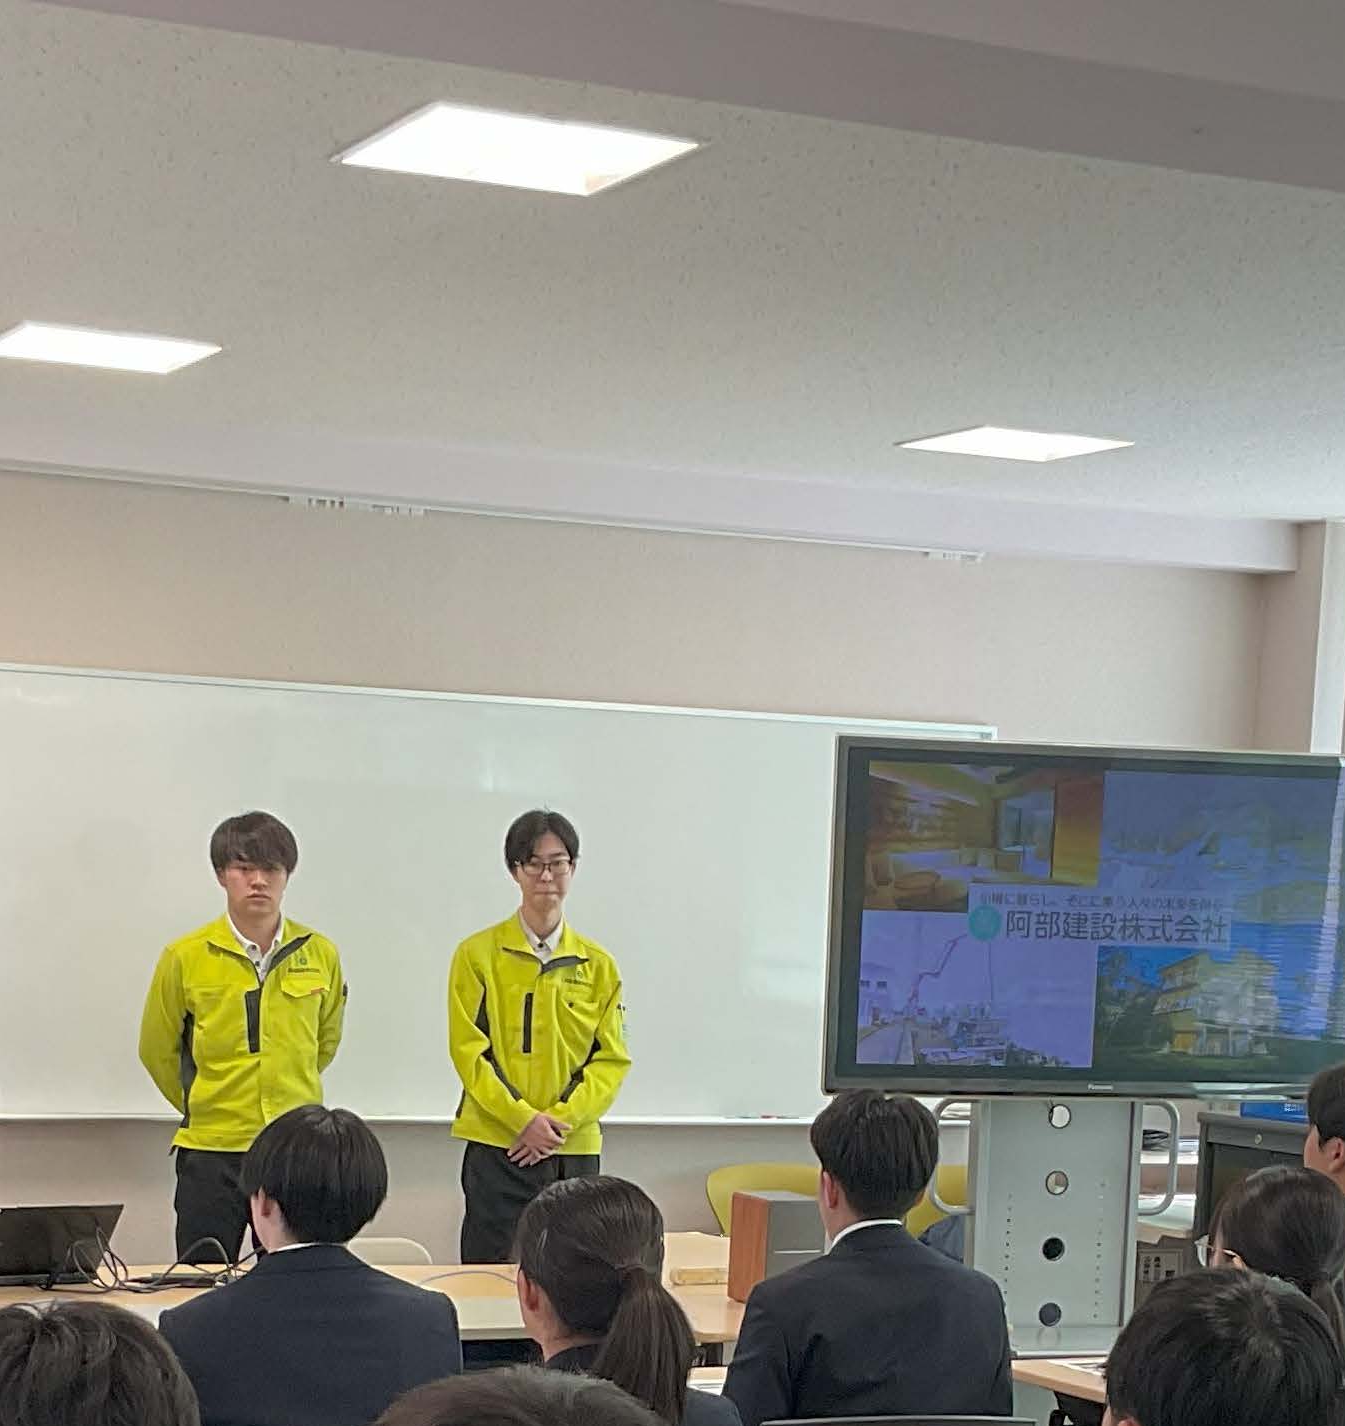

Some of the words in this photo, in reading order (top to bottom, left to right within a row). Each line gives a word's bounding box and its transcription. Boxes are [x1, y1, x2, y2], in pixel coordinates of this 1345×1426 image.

[1006, 909, 1228, 944] 阿部建設株式会社
